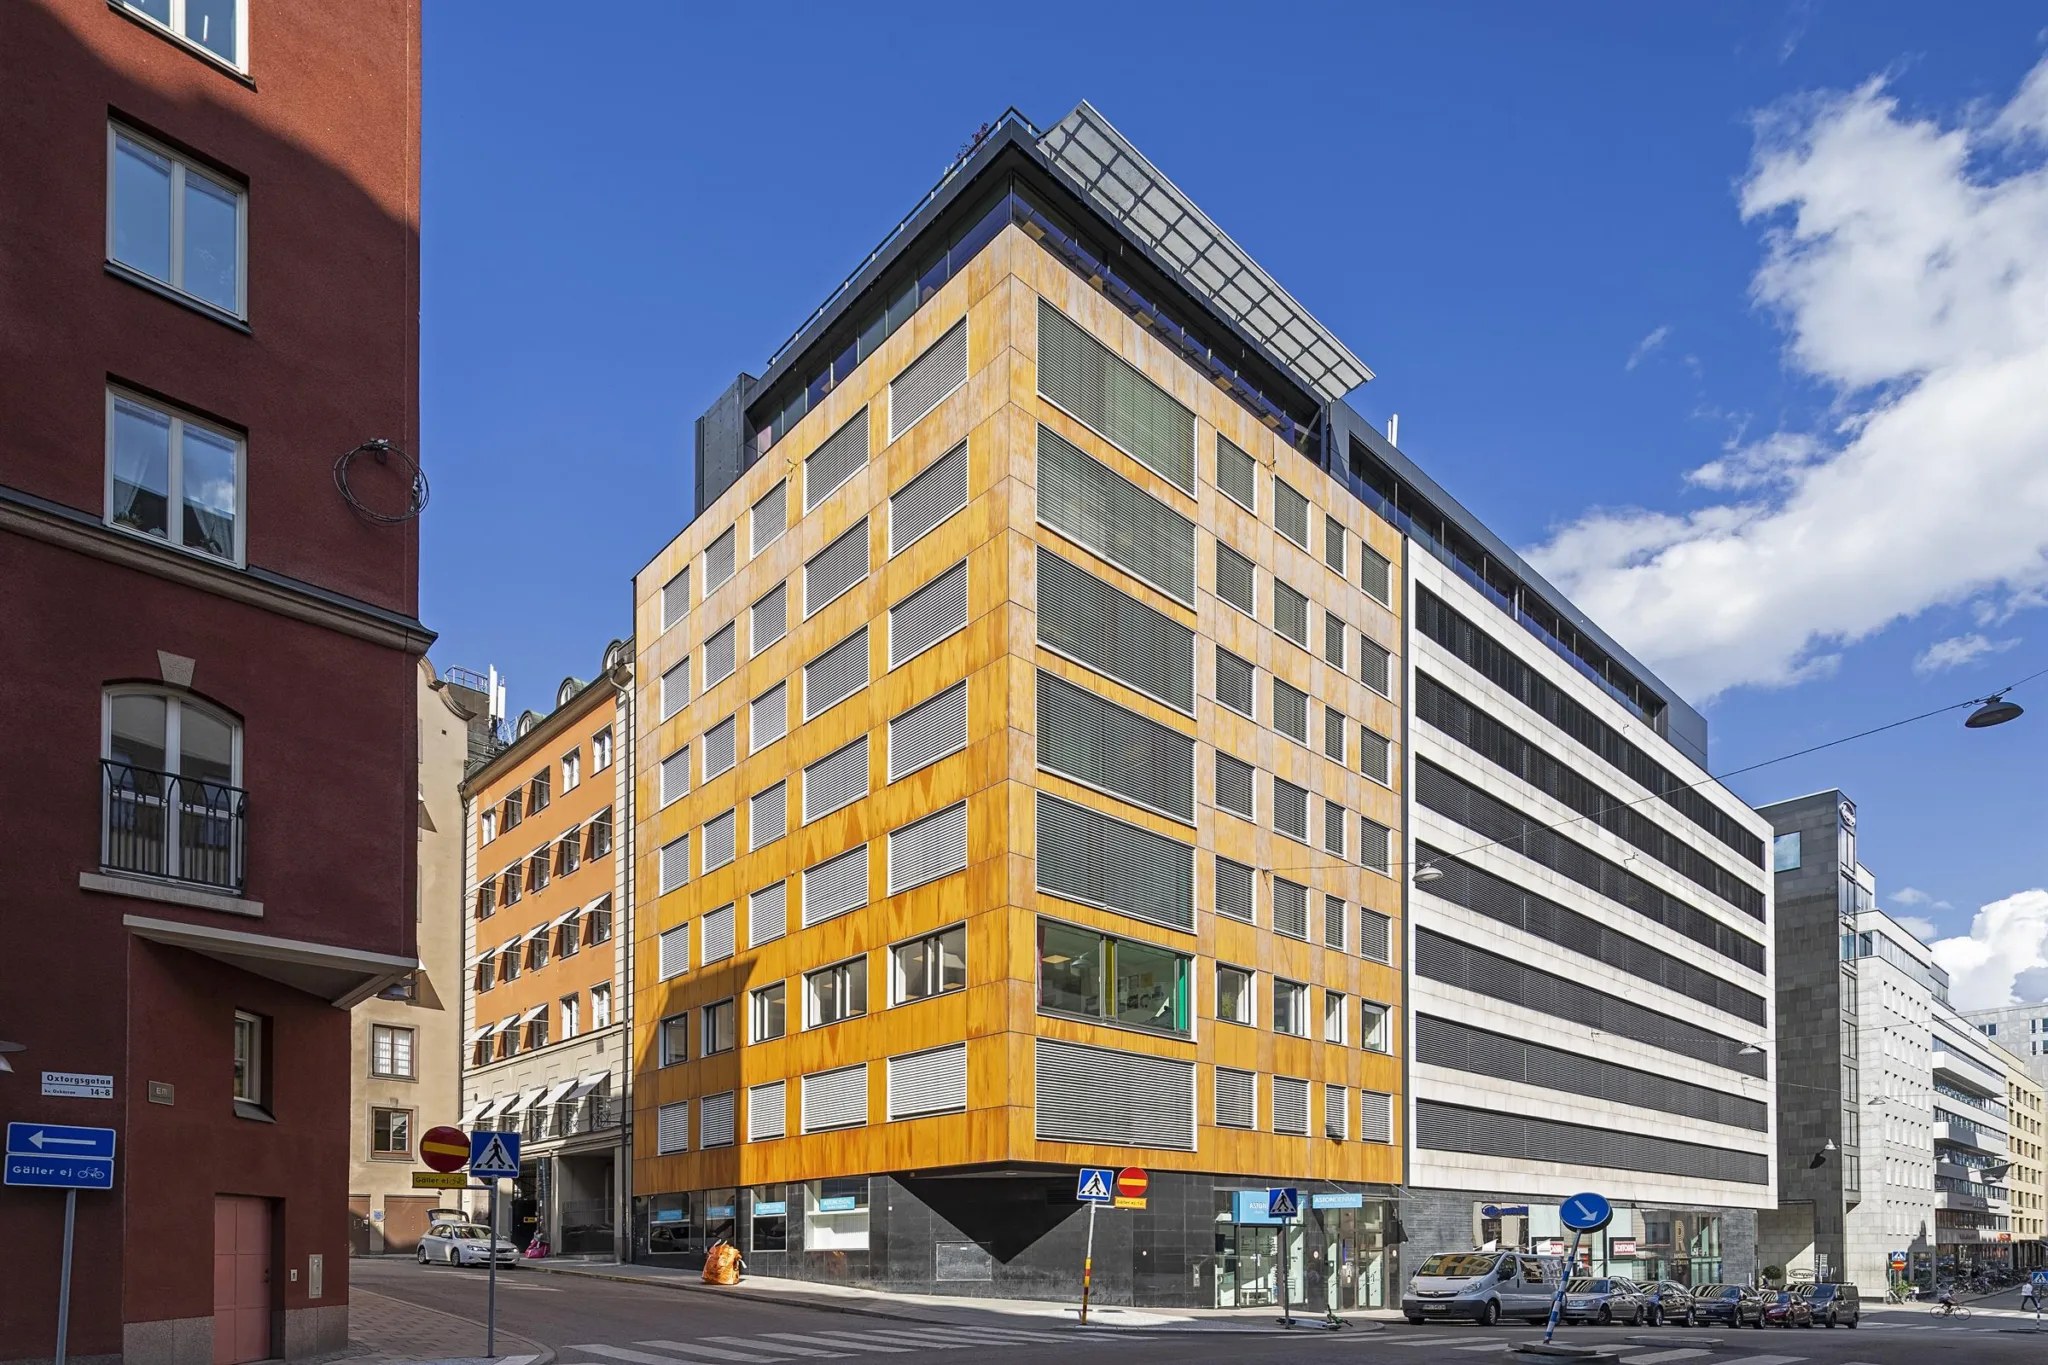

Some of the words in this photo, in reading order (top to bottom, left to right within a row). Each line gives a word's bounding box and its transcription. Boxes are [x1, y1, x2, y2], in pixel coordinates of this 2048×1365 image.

[46, 1074, 111, 1085] Oxtorgsgatan
[90, 1088, 111, 1097] 14-8
[12, 1165, 55, 1175] Gäller
[60, 1168, 72, 1178] ej
[415, 1176, 440, 1184] Gäller
